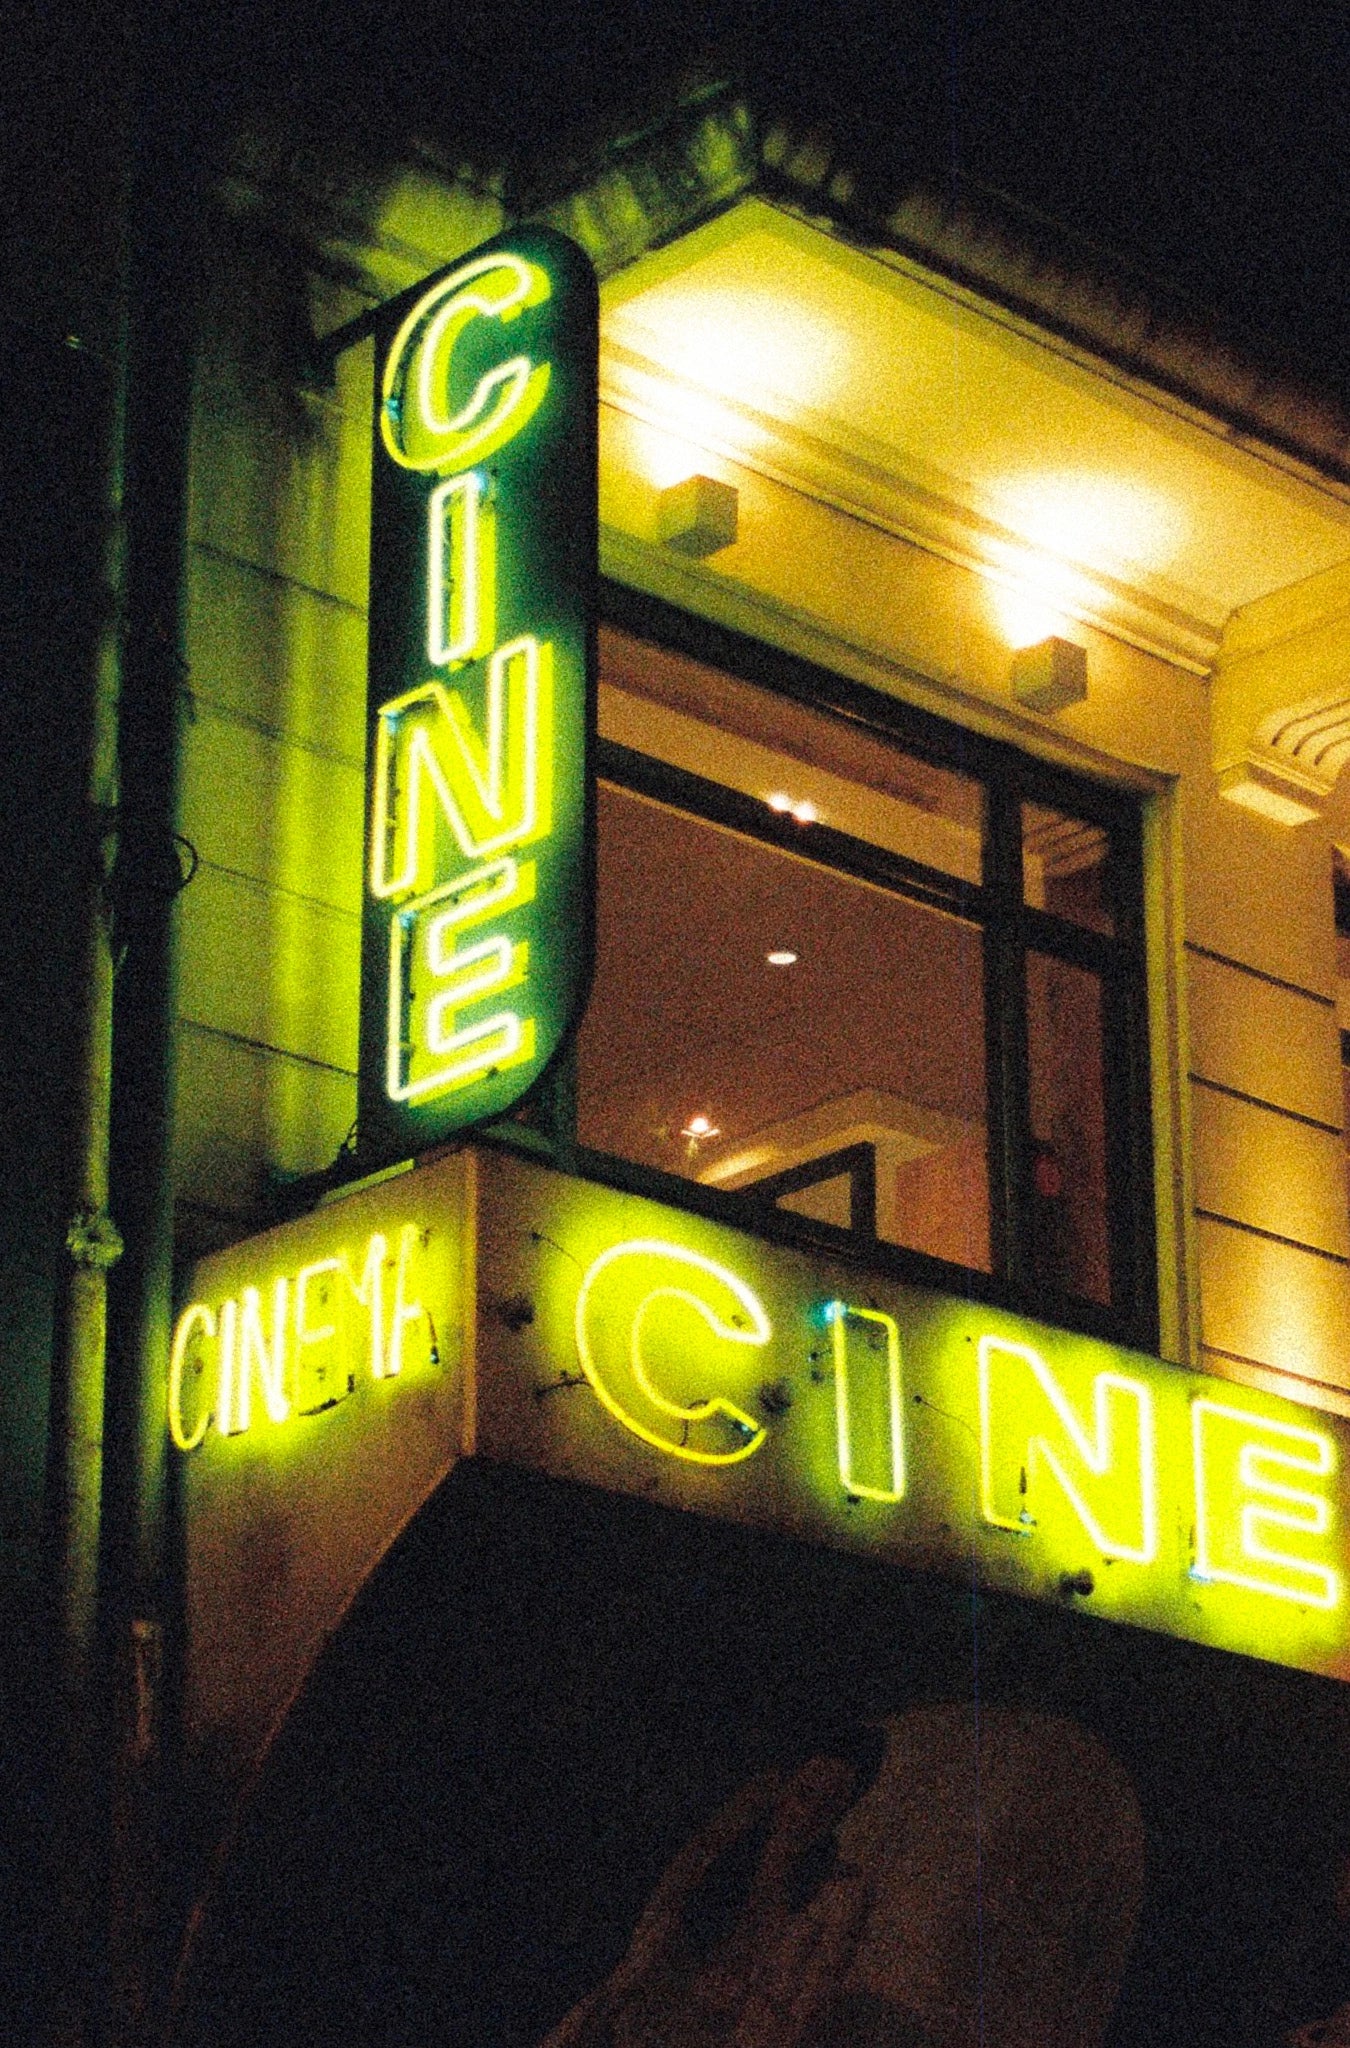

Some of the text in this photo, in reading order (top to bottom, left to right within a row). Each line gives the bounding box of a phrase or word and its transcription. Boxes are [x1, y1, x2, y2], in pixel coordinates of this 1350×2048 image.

[368, 253, 552, 1108] CINE
[168, 1224, 440, 1451] CINEMA
[575, 1239, 1341, 1610] CINE
